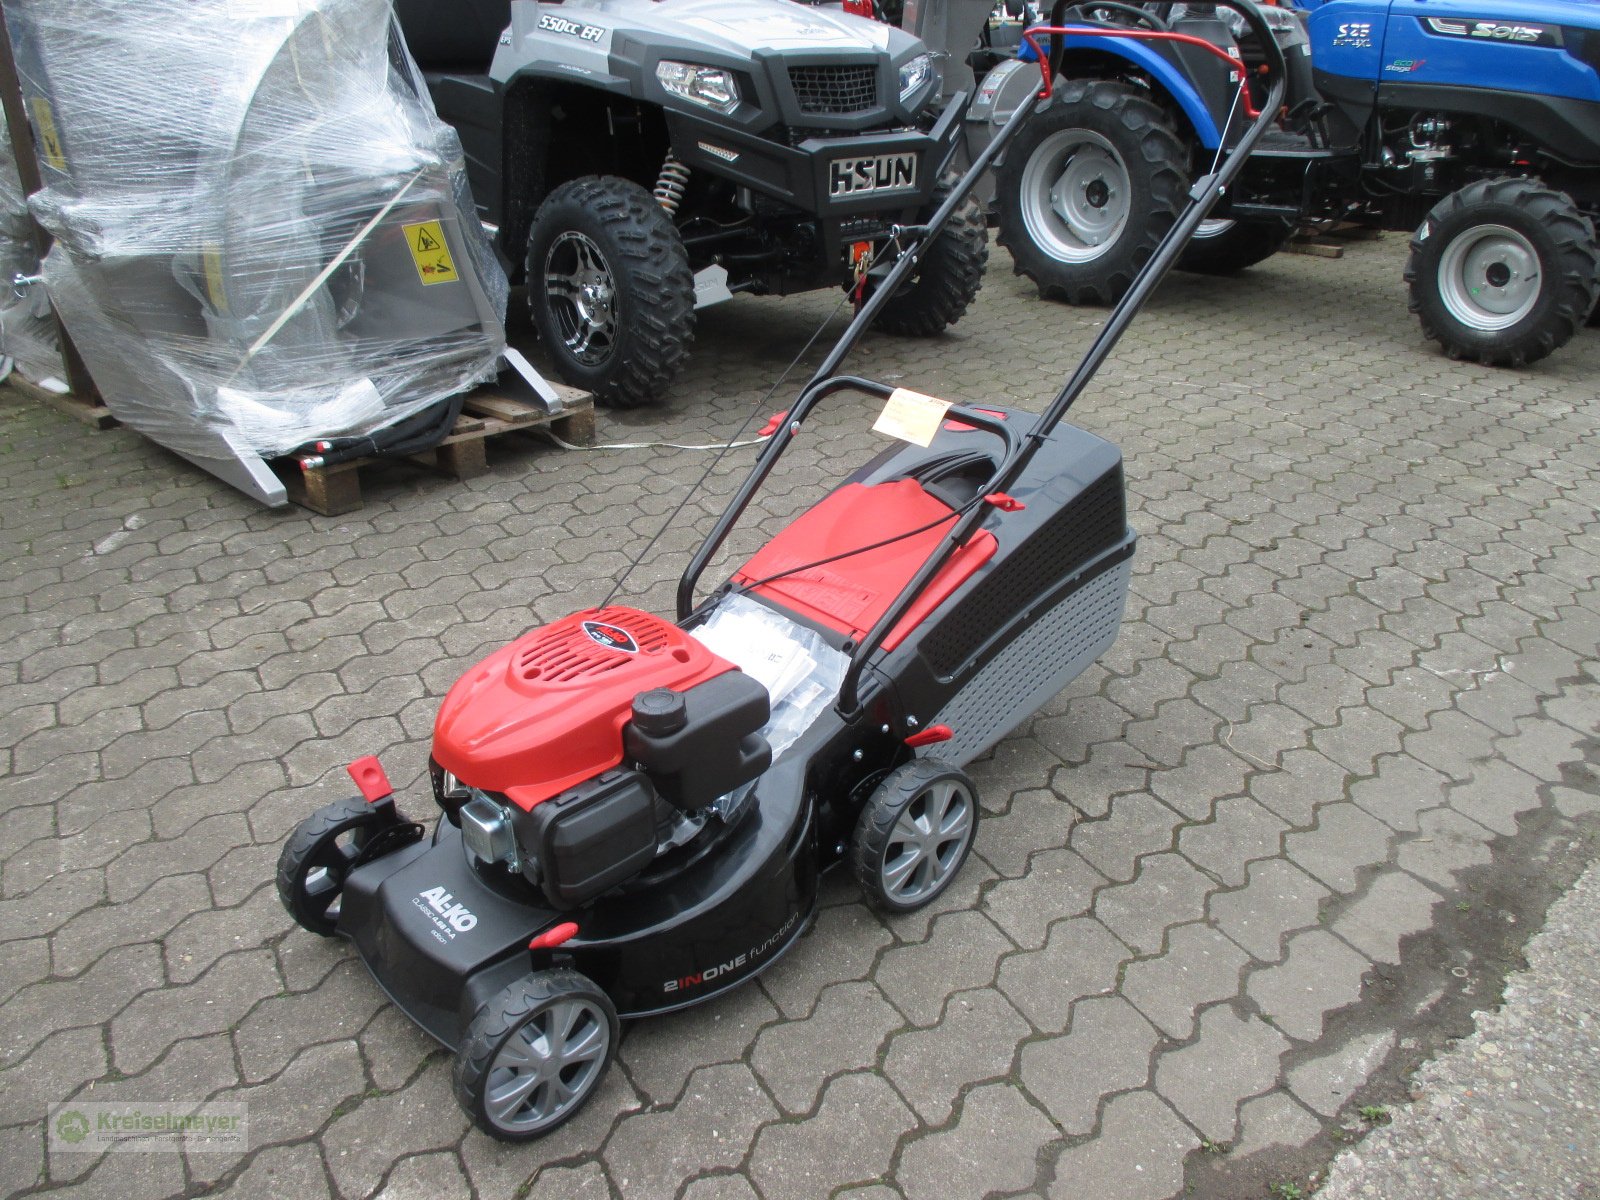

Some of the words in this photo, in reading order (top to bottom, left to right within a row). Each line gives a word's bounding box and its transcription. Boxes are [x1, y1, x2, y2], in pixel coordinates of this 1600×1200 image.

[538, 14, 581, 35] 550cc
[580, 25, 605, 42] EFI
[830, 156, 914, 195] HSUN
[419, 886, 479, 932] AL-KO
[749, 911, 800, 959] function
